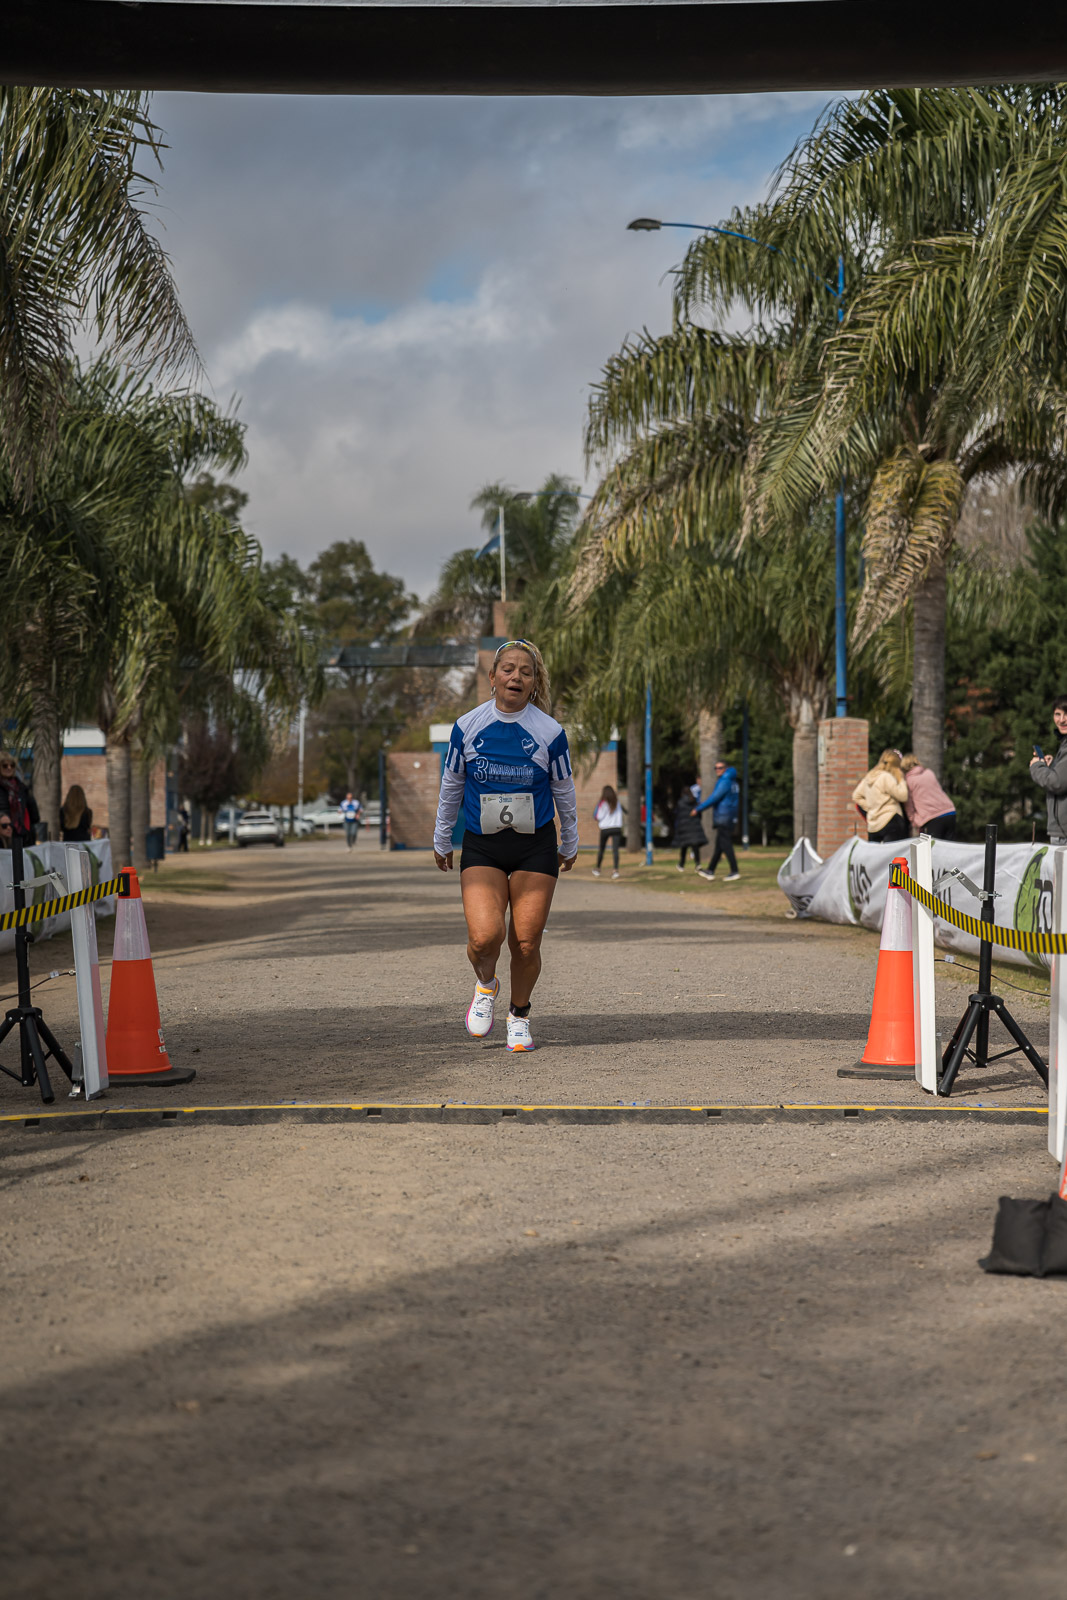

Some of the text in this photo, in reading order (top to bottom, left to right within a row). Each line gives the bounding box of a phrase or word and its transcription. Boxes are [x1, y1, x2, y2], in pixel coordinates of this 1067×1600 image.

[474, 756, 489, 783] 3
[489, 763, 534, 777] MARATÓN
[500, 805, 513, 824] 6
